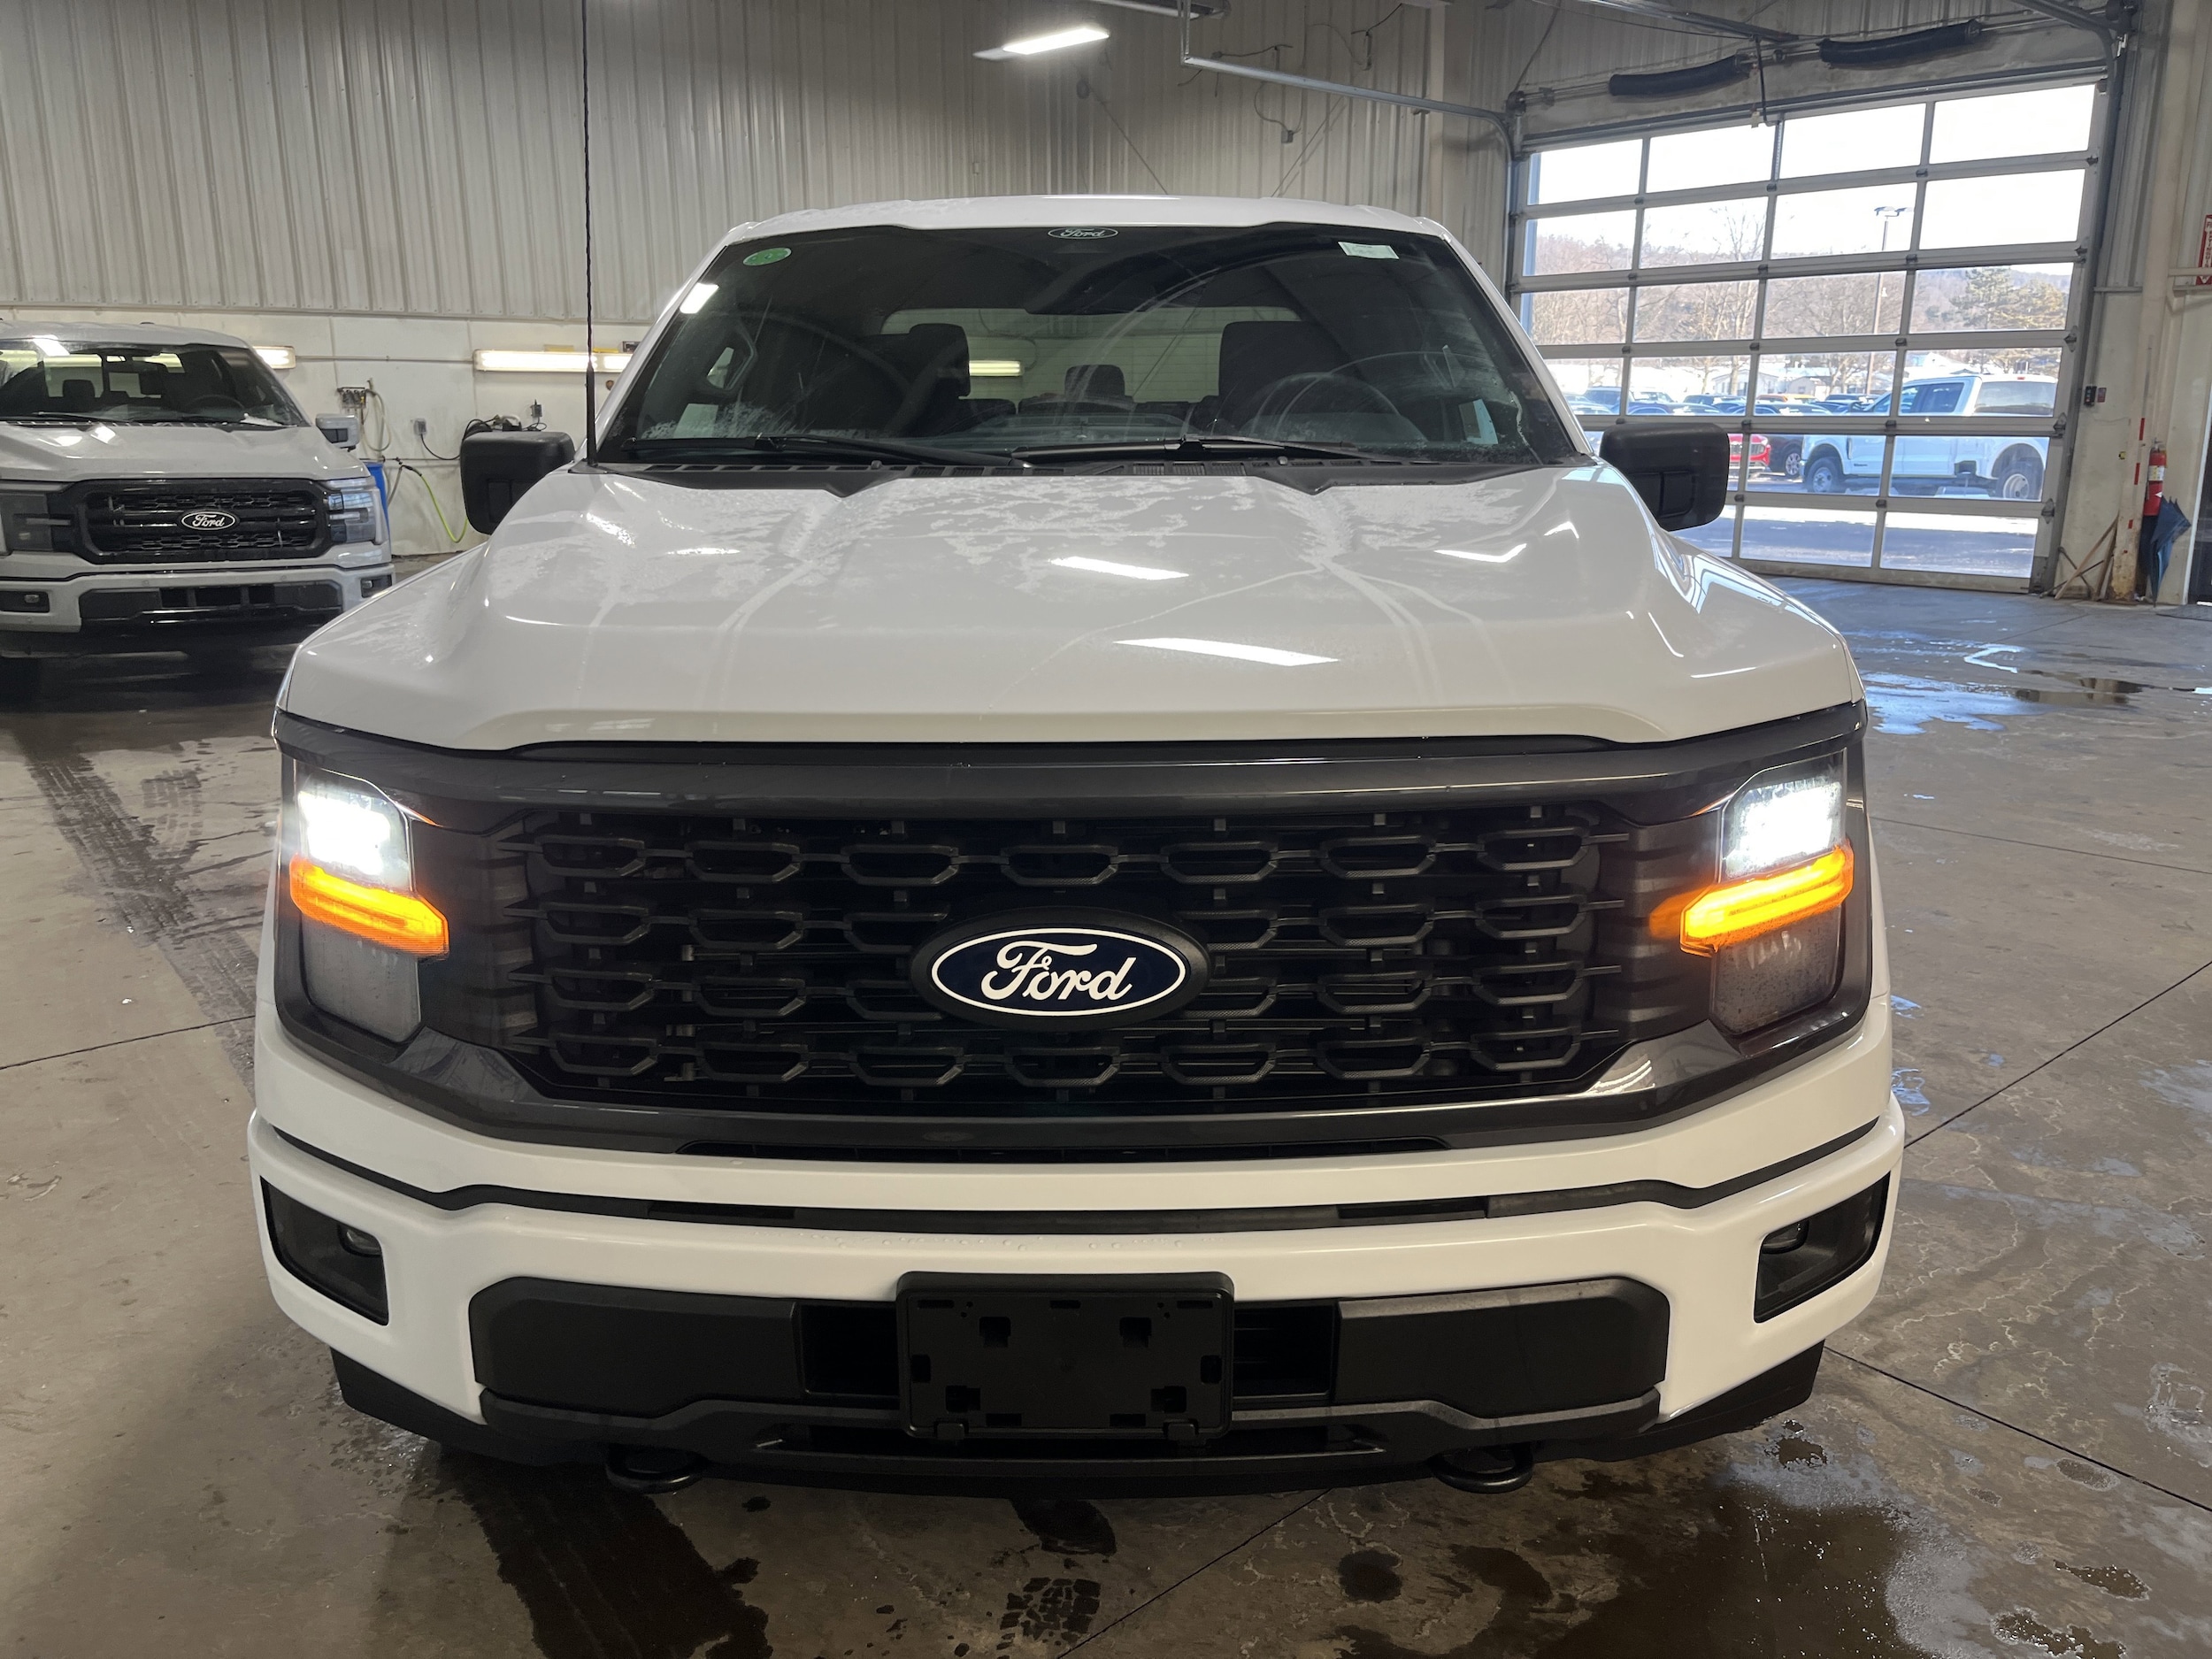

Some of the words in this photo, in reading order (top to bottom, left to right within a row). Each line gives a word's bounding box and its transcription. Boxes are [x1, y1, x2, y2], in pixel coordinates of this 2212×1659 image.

[1061, 227, 1105, 237] Ford
[192, 514, 225, 526] Ford
[980, 941, 1137, 1000] Ford
